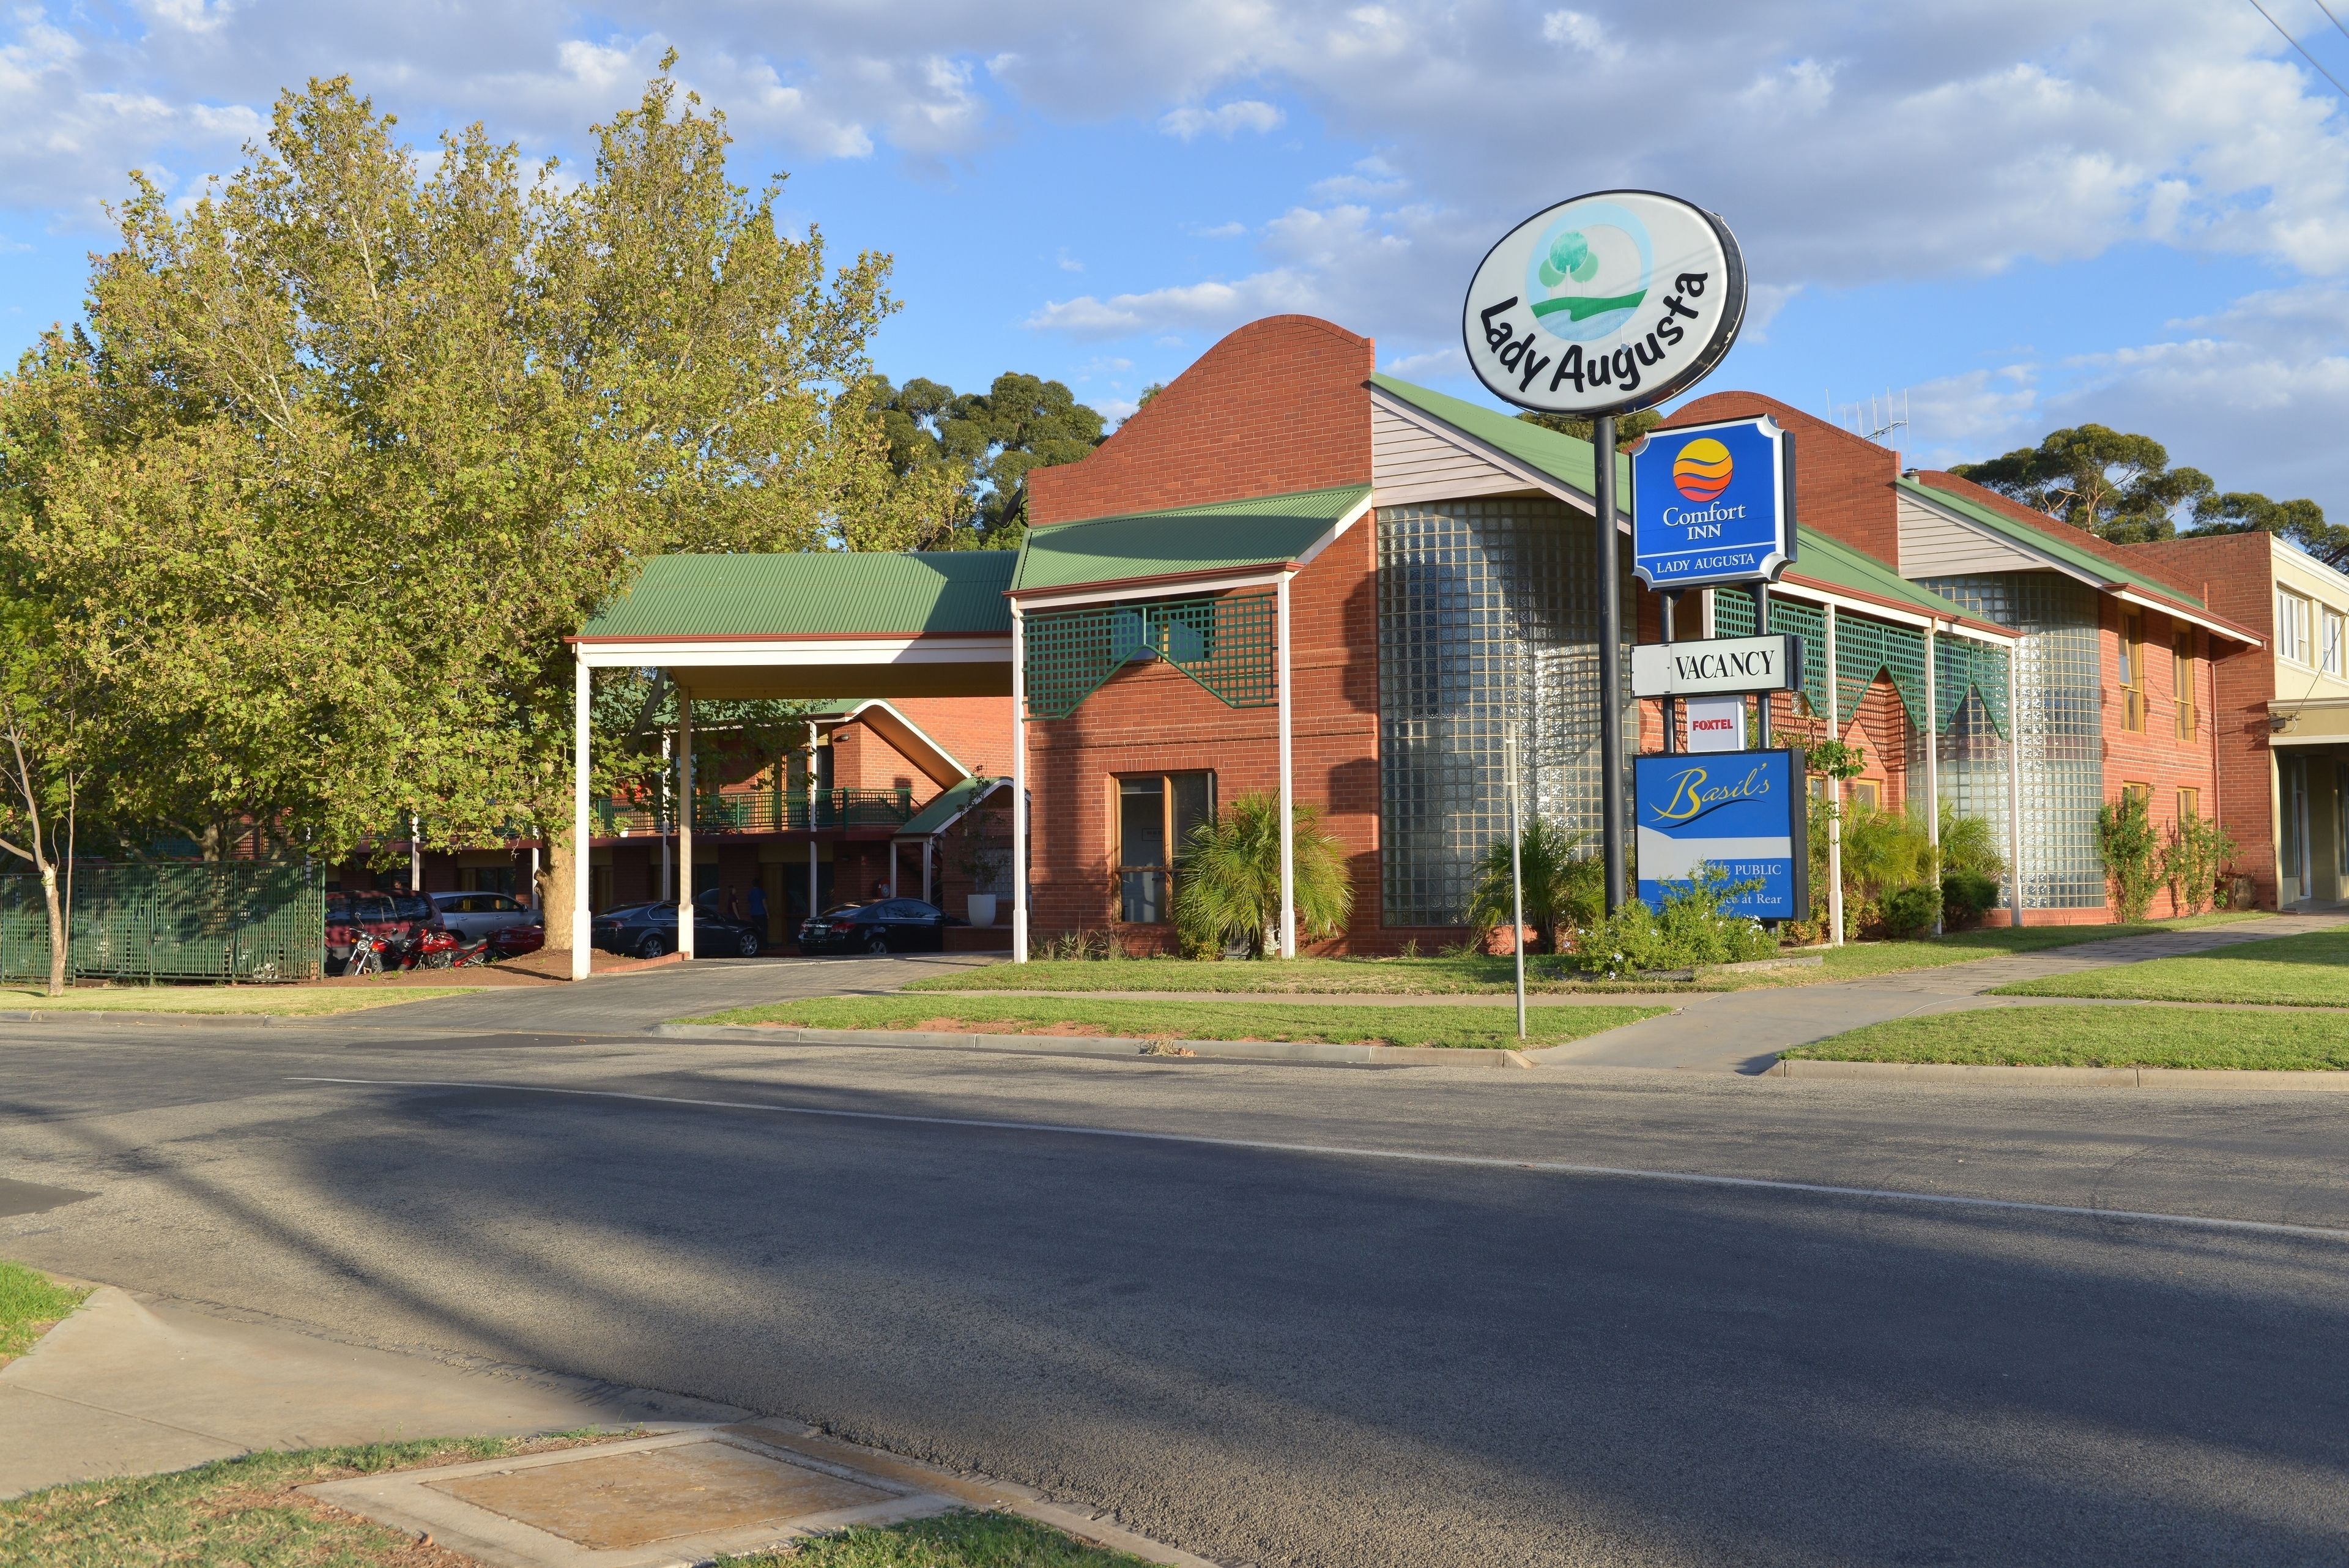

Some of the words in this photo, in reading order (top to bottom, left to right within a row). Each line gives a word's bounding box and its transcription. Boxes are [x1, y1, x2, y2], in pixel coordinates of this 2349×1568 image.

[1480, 295, 1551, 393] Lady
[1549, 272, 1709, 392] Augusta
[1663, 501, 1746, 526] Comfort
[1687, 524, 1721, 540] INN
[1656, 560, 1690, 574] LADY
[1694, 553, 1755, 570] AUGUSTA
[1675, 650, 1775, 680] VACANCY
[1693, 718, 1733, 731] FOXTEL
[1649, 762, 1770, 822] Basil's
[1706, 864, 1731, 875] TE
[1735, 864, 1781, 875] PUBLIC
[1742, 895, 1752, 904] at
[1756, 894, 1782, 904] Rear
